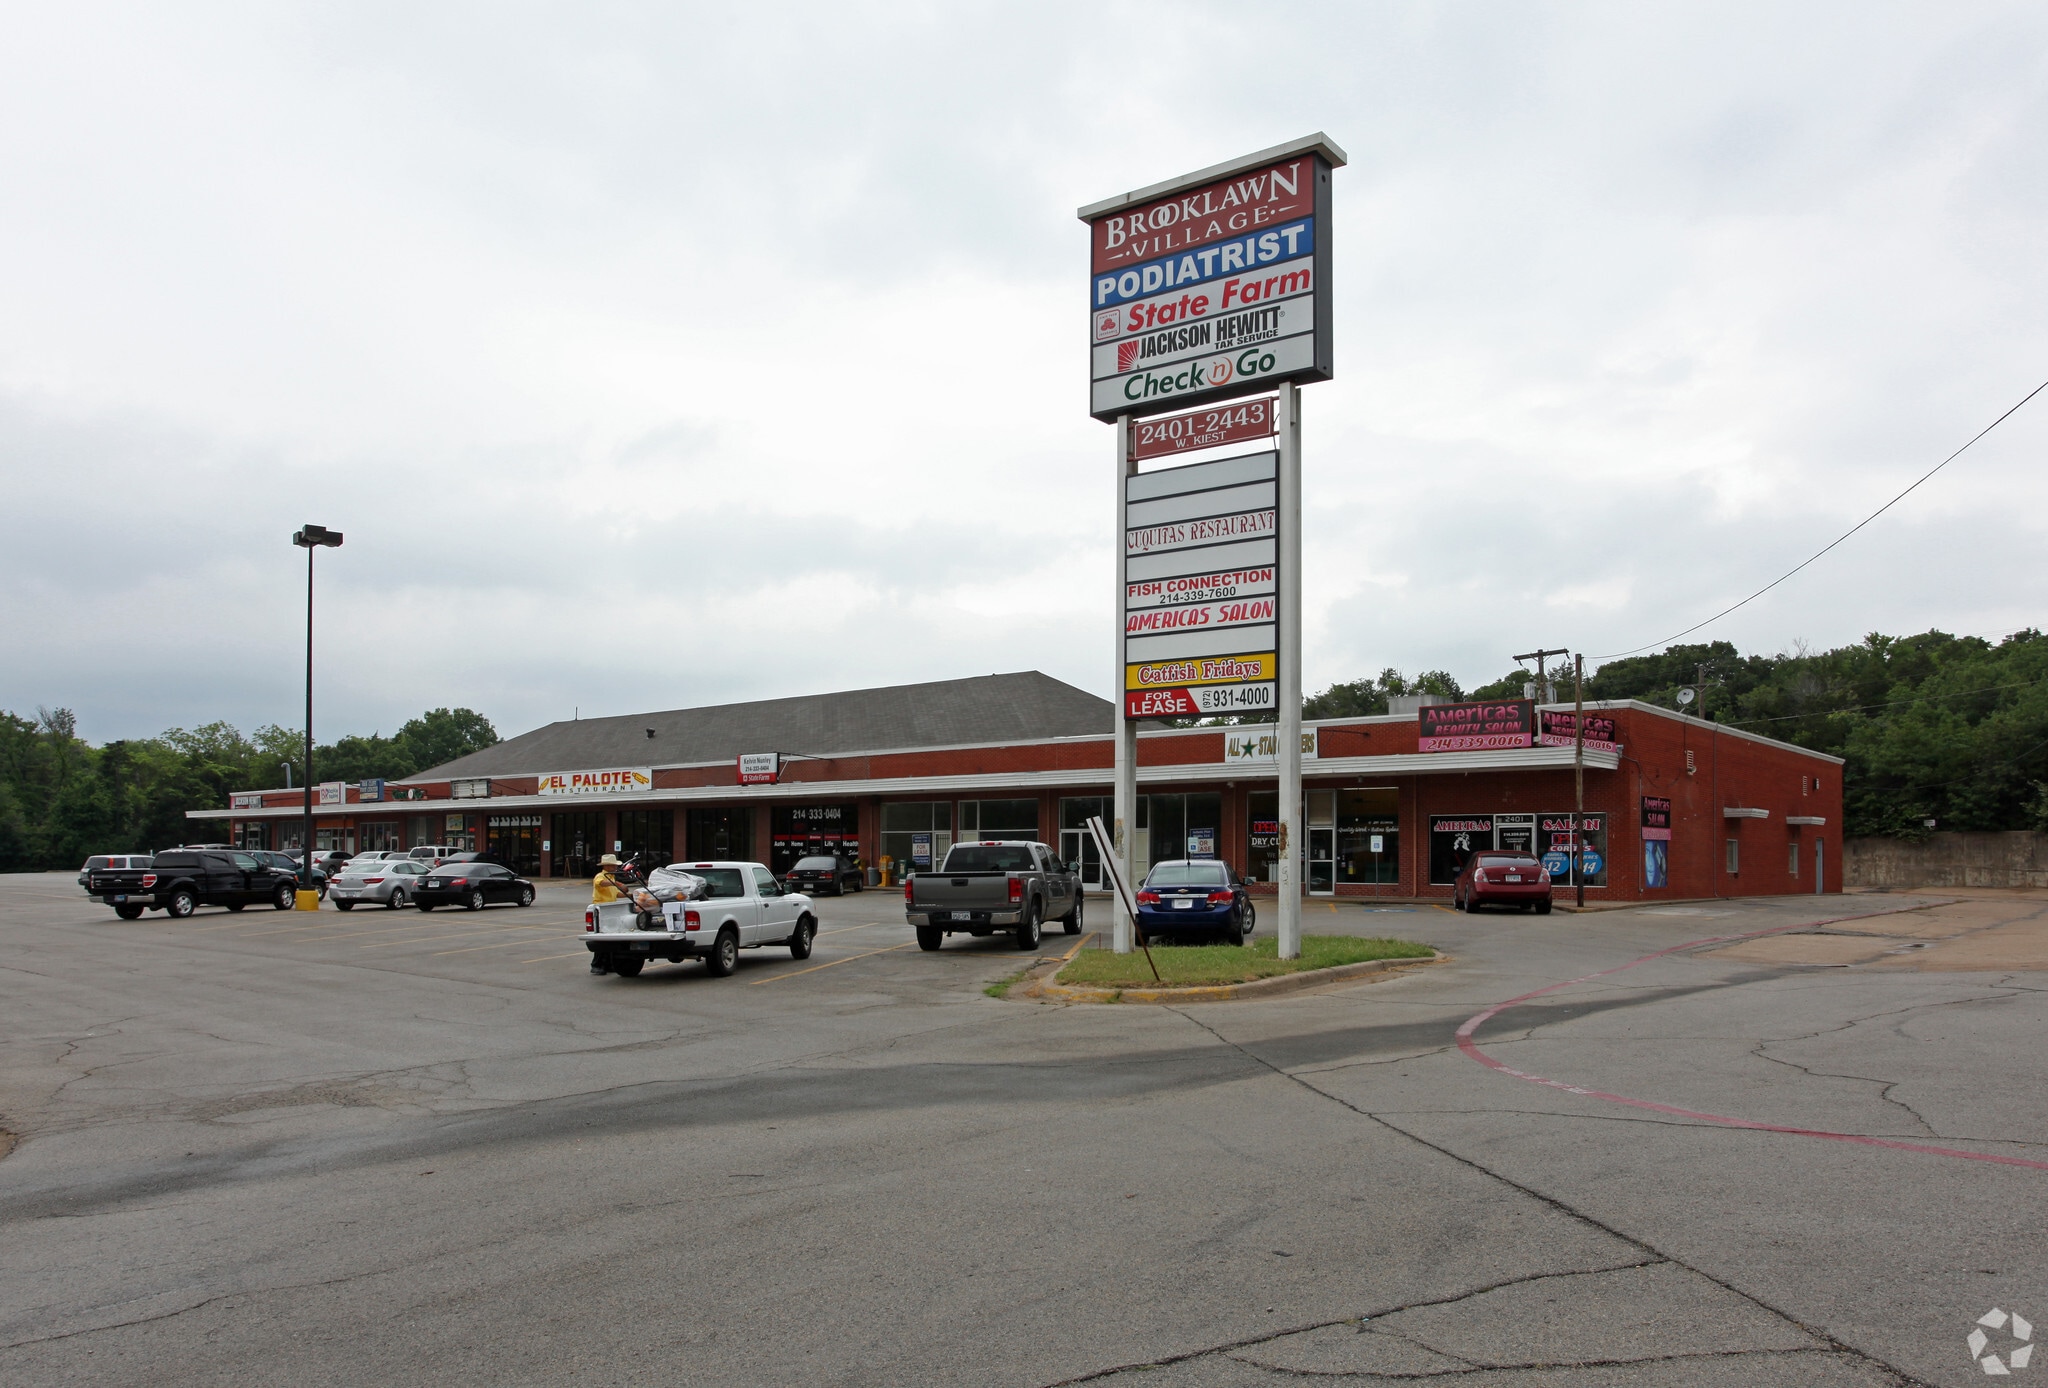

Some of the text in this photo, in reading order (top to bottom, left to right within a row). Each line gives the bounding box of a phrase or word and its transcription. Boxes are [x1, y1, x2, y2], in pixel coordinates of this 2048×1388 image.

[1105, 163, 1300, 249] BROOKLAWN
[1132, 205, 1268, 257] VILLAGE
[1097, 224, 1305, 305] PODIATRIST
[1126, 268, 1310, 331] State Farm
[1140, 322, 1211, 360] JACKSON
[1214, 328, 1279, 350] TAX SERVICE
[1124, 362, 1205, 400] Check
[1236, 348, 1276, 376] Go
[1141, 404, 1265, 444] 2401-2443
[1176, 430, 1226, 448] W. KIEST
[1128, 512, 1274, 550] CUQUITAS RESTAURANT
[1128, 568, 1272, 598] FISH CONNECTION
[1160, 586, 1236, 604] 214-339-7600
[1126, 600, 1274, 632] AMERICAS SALON
[1138, 658, 1261, 684] Catfish Fridays
[1132, 698, 1187, 715] LEASE
[1145, 692, 1172, 701] FOR
[1202, 686, 1269, 708] (972) 931-4000
[1435, 720, 1522, 735] BEAUTY SALON
[1228, 737, 1240, 756] ALL
[1258, 736, 1278, 756] STAR
[550, 772, 631, 788] EL PALOTE
[553, 785, 634, 794] RESTAURANT
[1254, 822, 1278, 832] OPEN
[1434, 819, 1491, 832] AMERICAS
